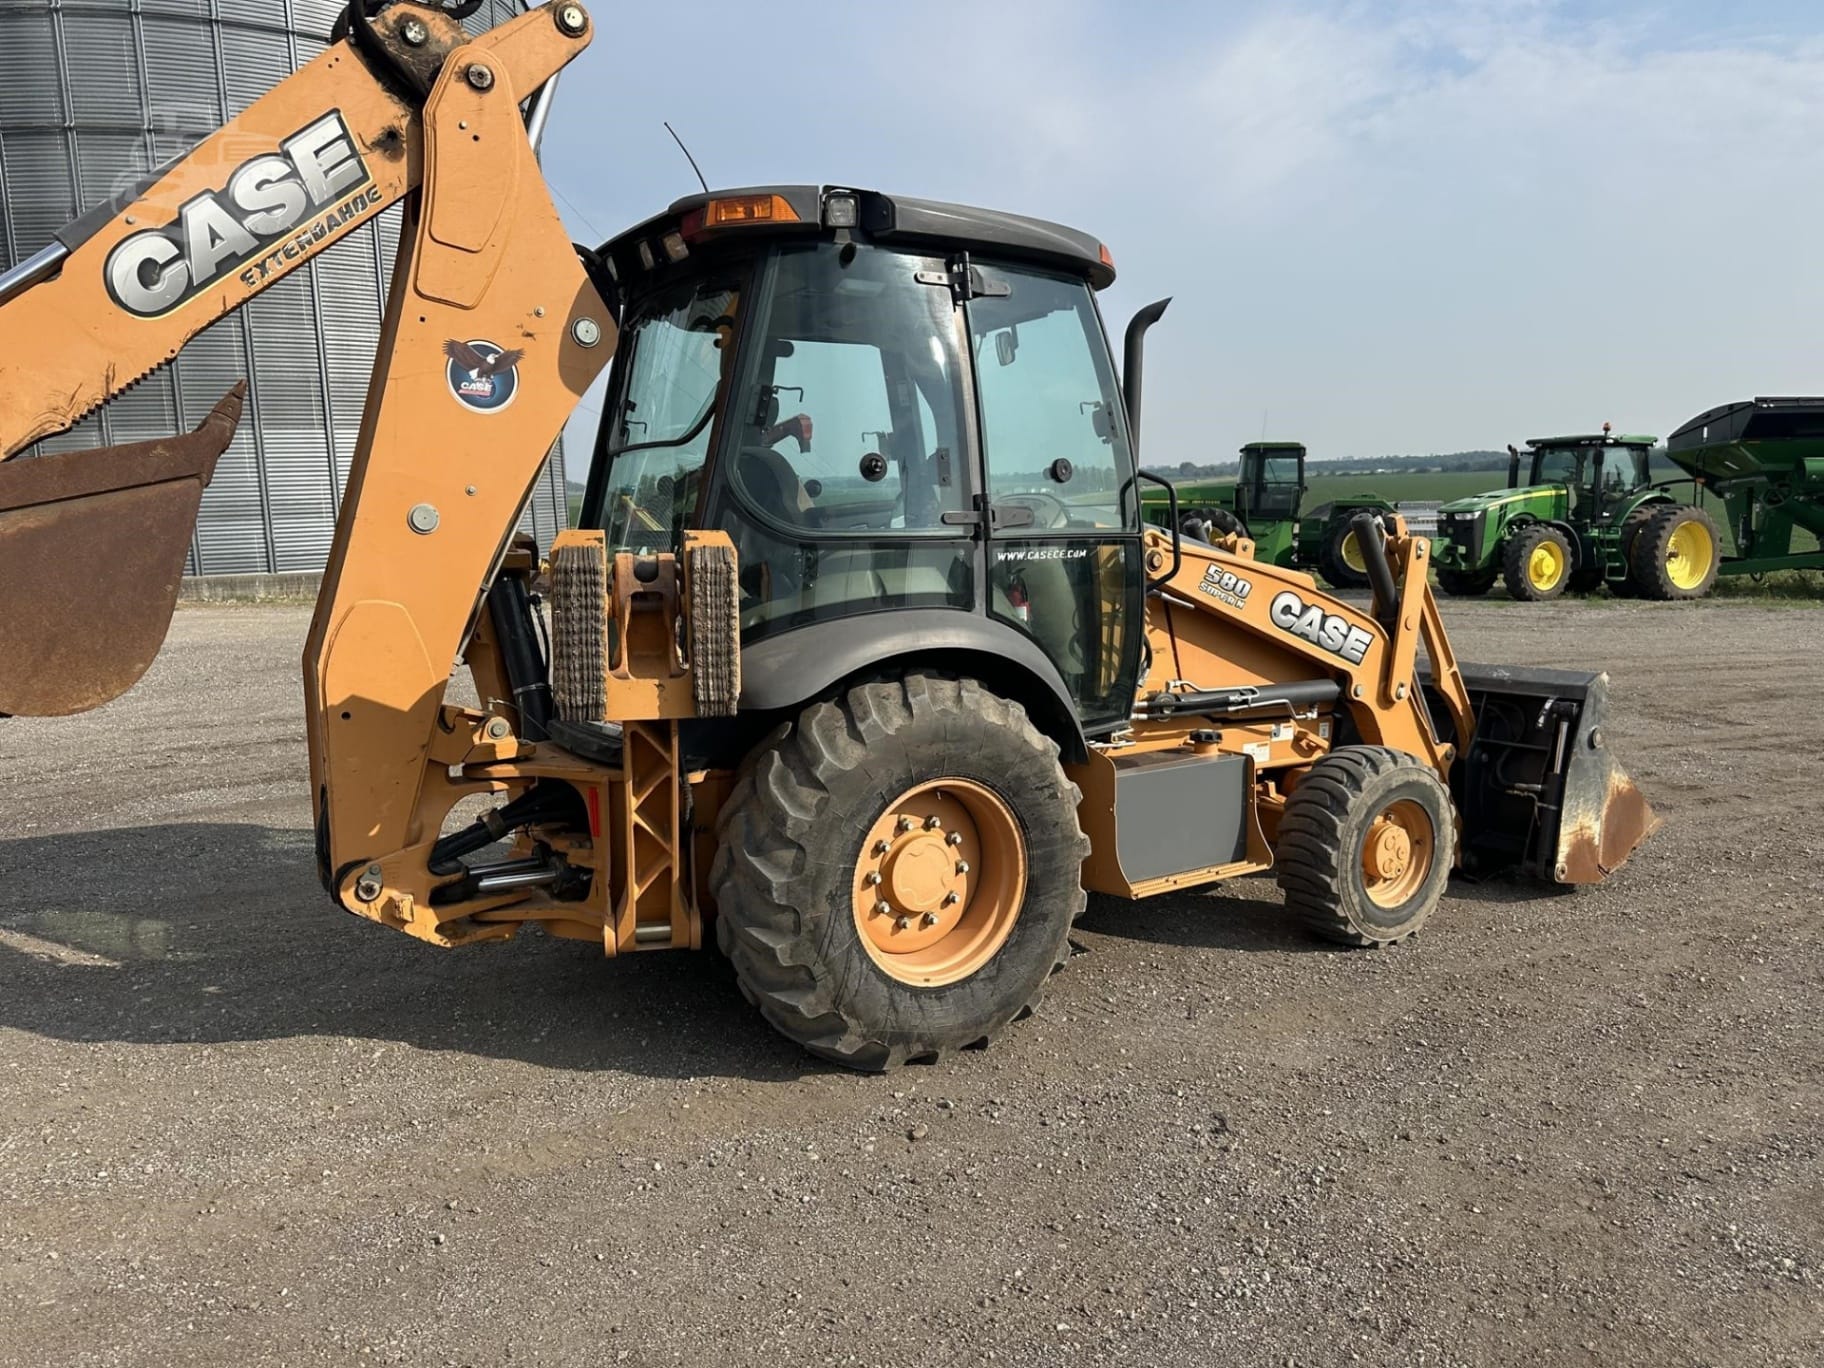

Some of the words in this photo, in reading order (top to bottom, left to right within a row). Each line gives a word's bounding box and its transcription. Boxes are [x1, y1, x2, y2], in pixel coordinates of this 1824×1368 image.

[104, 110, 370, 317] CASE
[240, 184, 383, 287] EXTENDAHOE
[461, 382, 493, 392] CASE
[1204, 563, 1252, 599] 580
[1270, 591, 1375, 666] CASE
